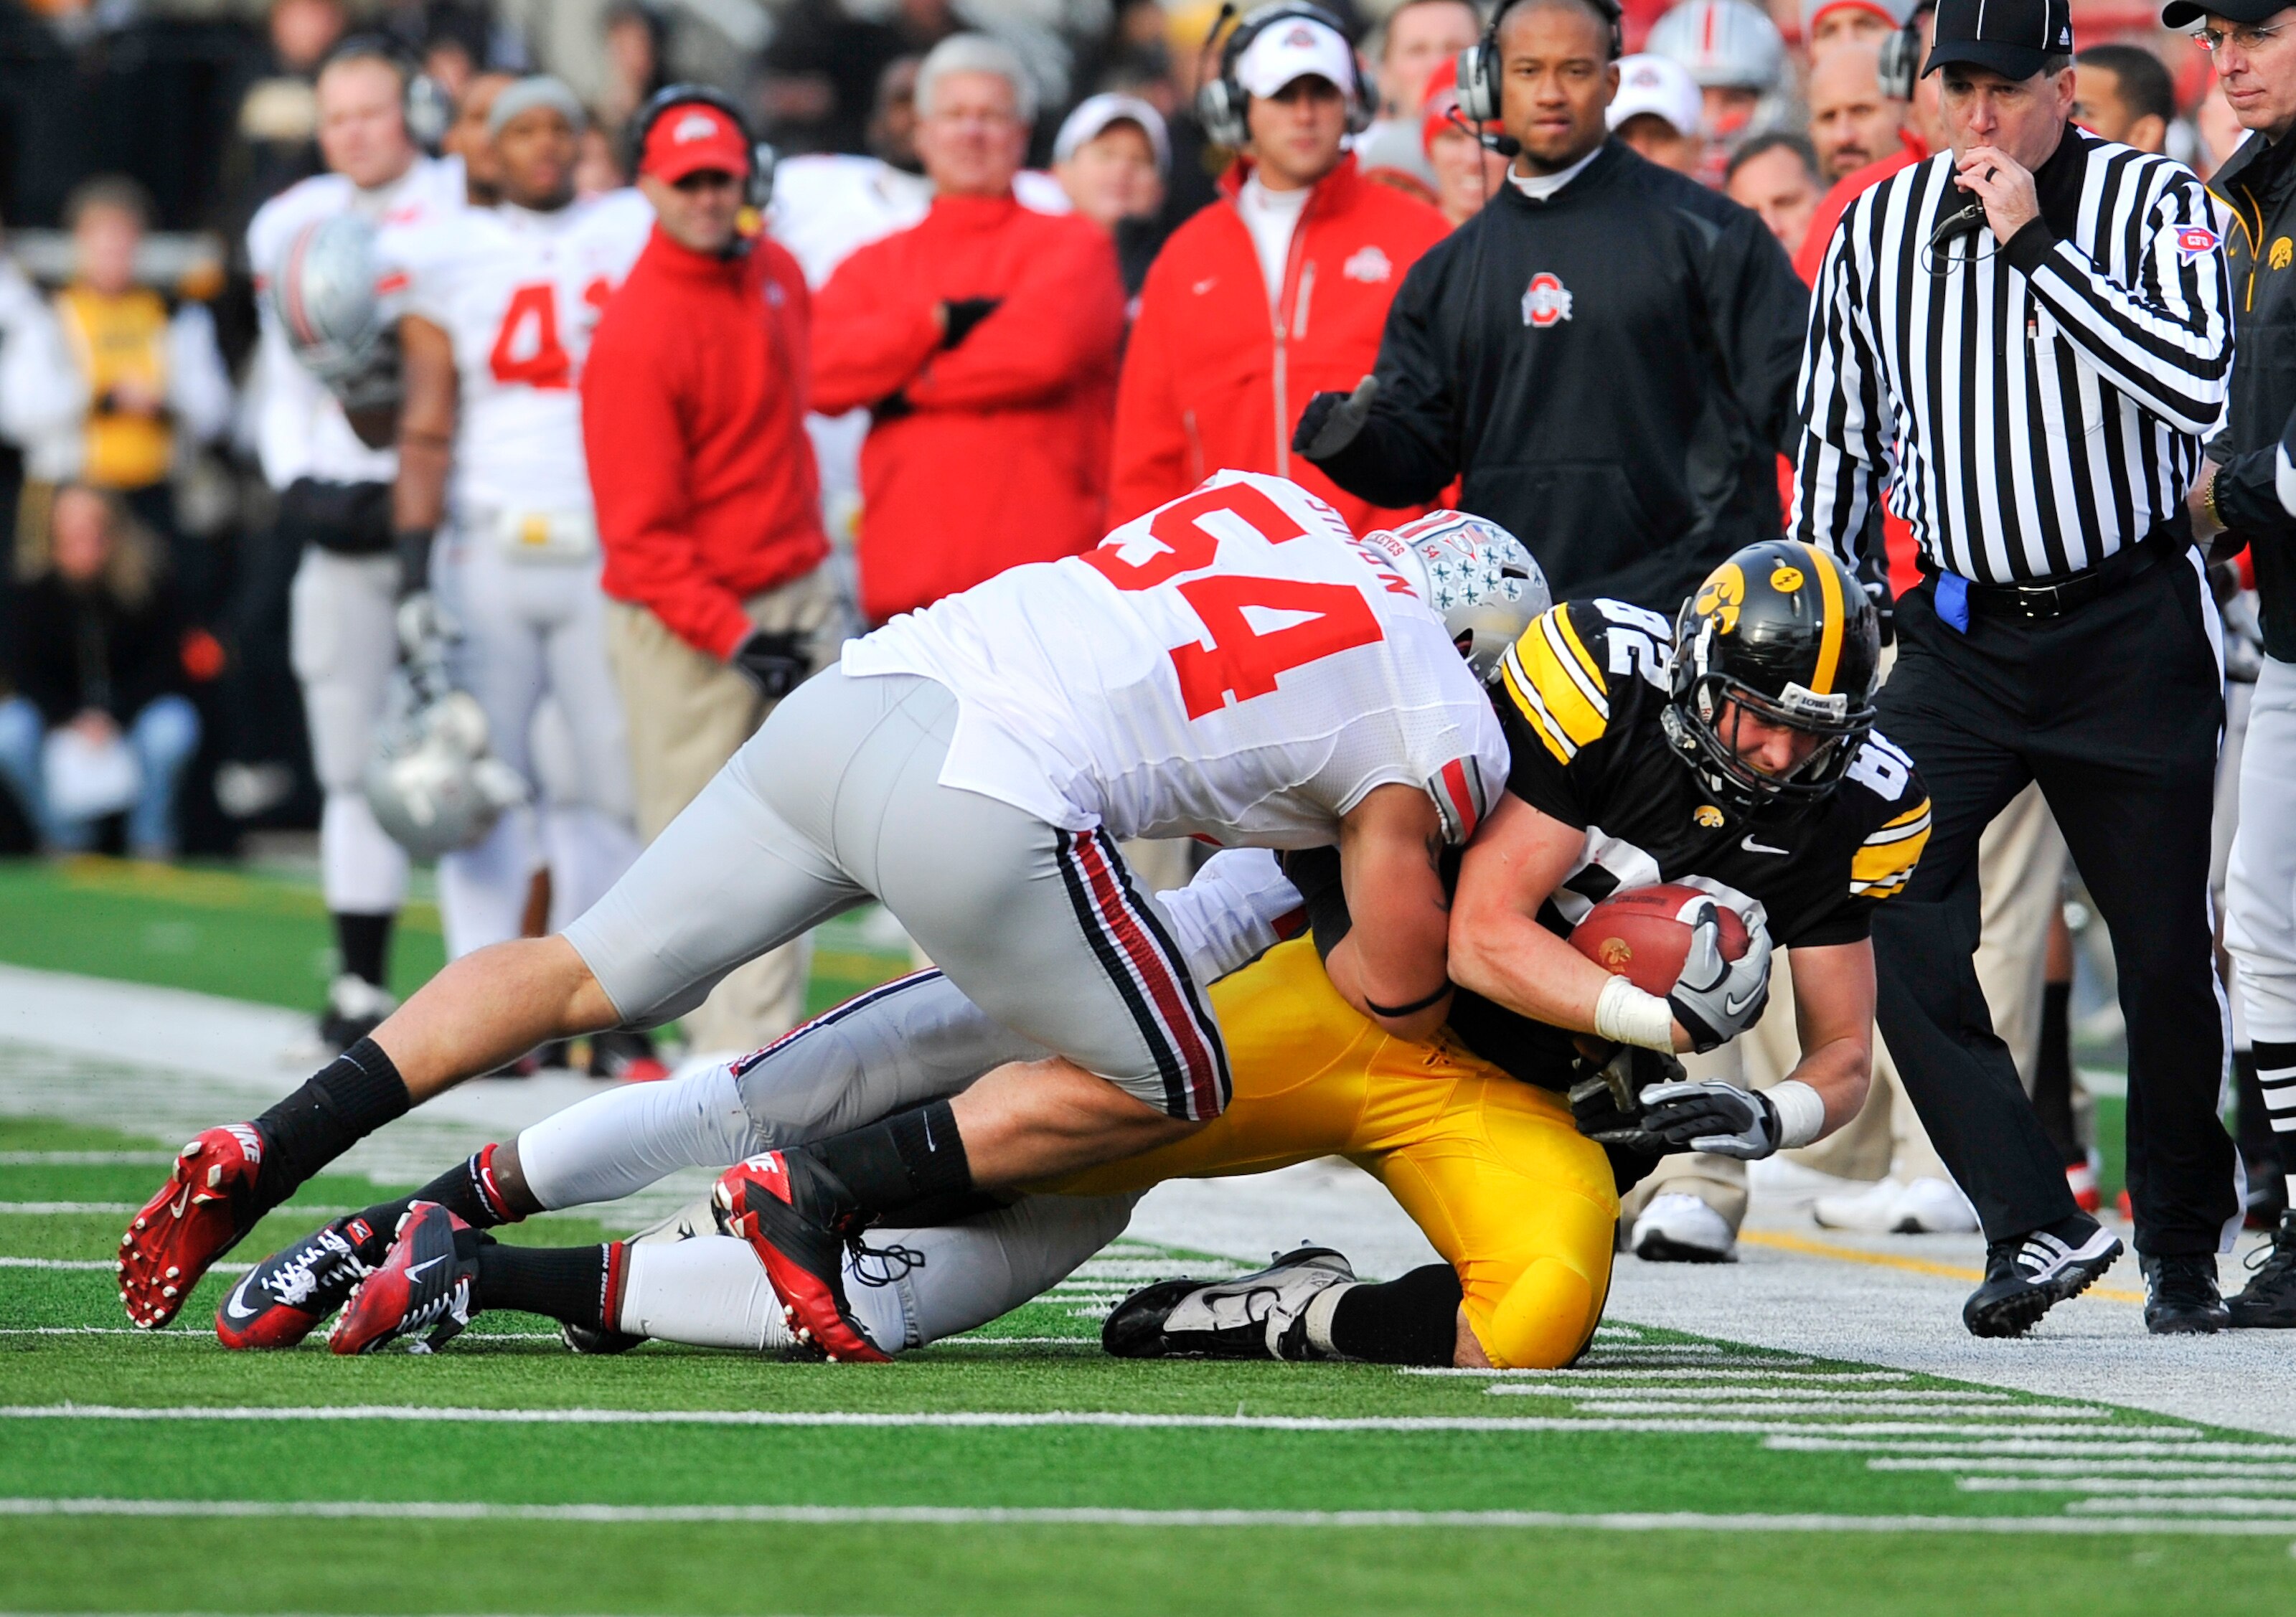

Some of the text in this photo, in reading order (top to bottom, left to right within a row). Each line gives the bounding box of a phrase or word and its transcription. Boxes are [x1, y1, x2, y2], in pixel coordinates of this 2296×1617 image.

[1421, 544, 1441, 559] 54
[1078, 481, 1385, 721] 54
[1592, 598, 1675, 692] 82
